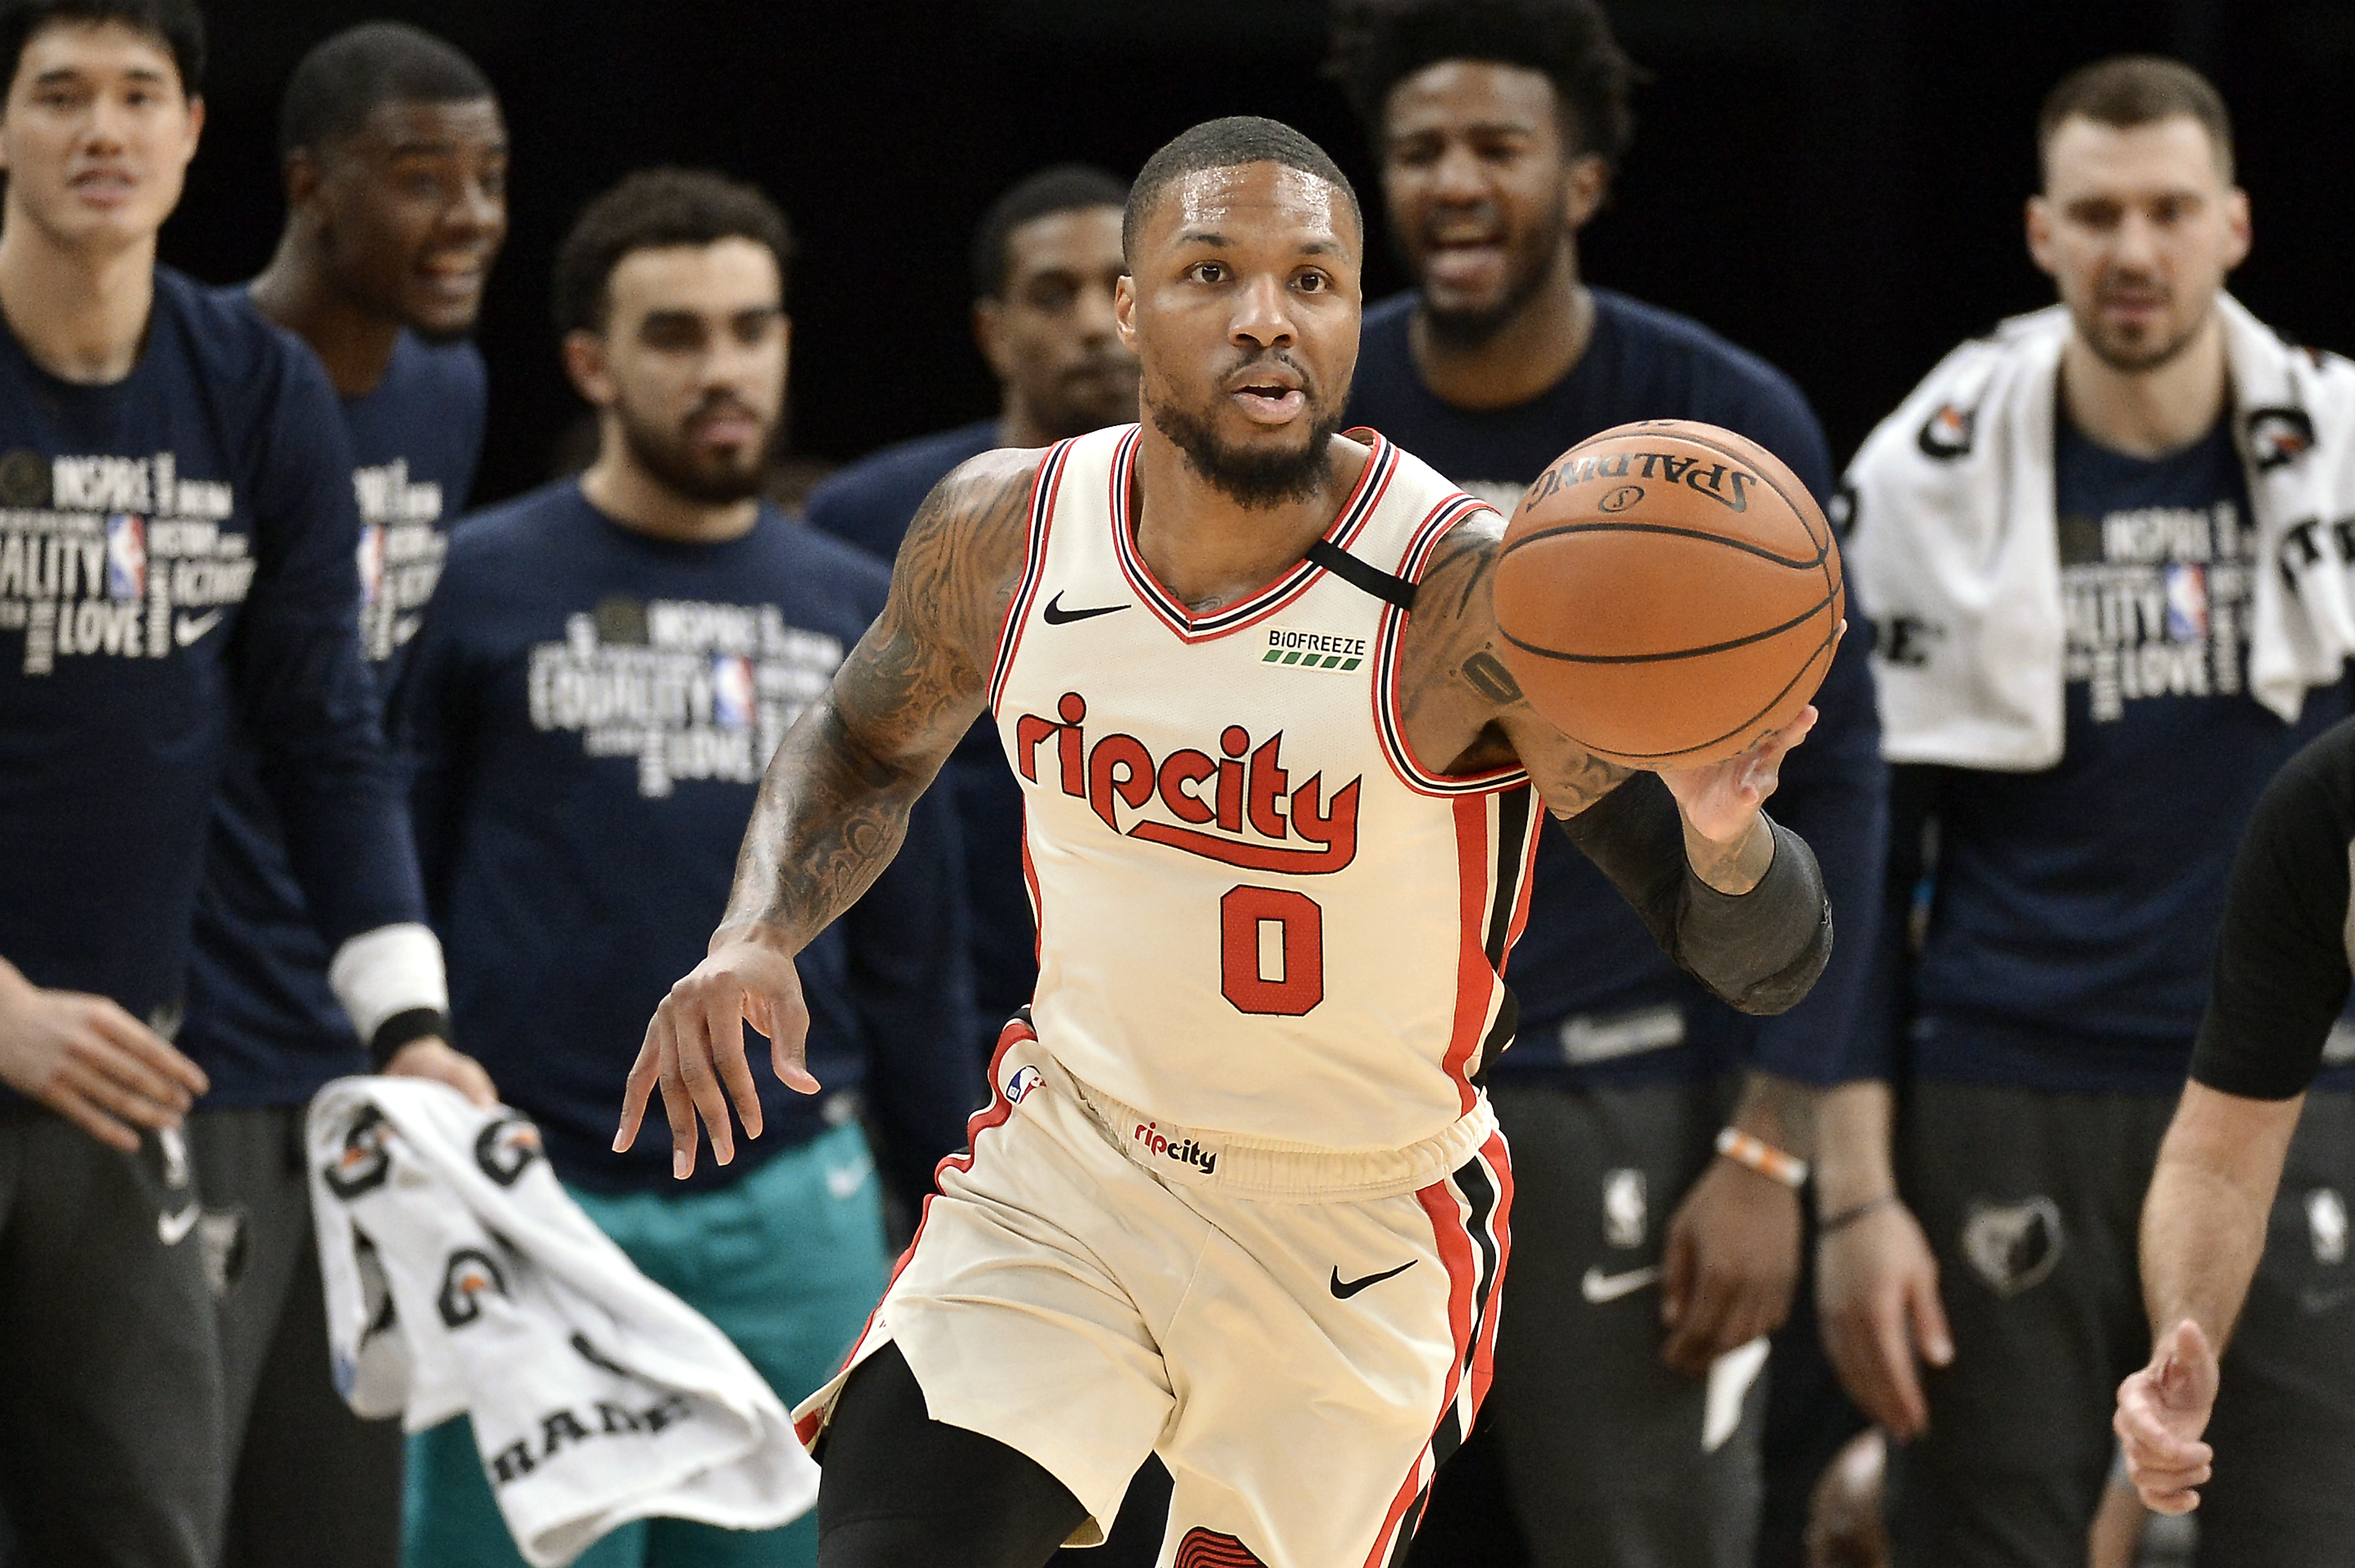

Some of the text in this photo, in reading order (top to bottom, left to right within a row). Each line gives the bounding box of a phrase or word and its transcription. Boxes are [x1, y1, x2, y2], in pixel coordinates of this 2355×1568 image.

[1526, 453, 1756, 513] SPALDING
[58, 600, 143, 656] LOVE
[1016, 691, 1363, 875] ripcity
[1220, 883, 1325, 1016] 0
[1133, 1121, 1219, 1175] ripcity
